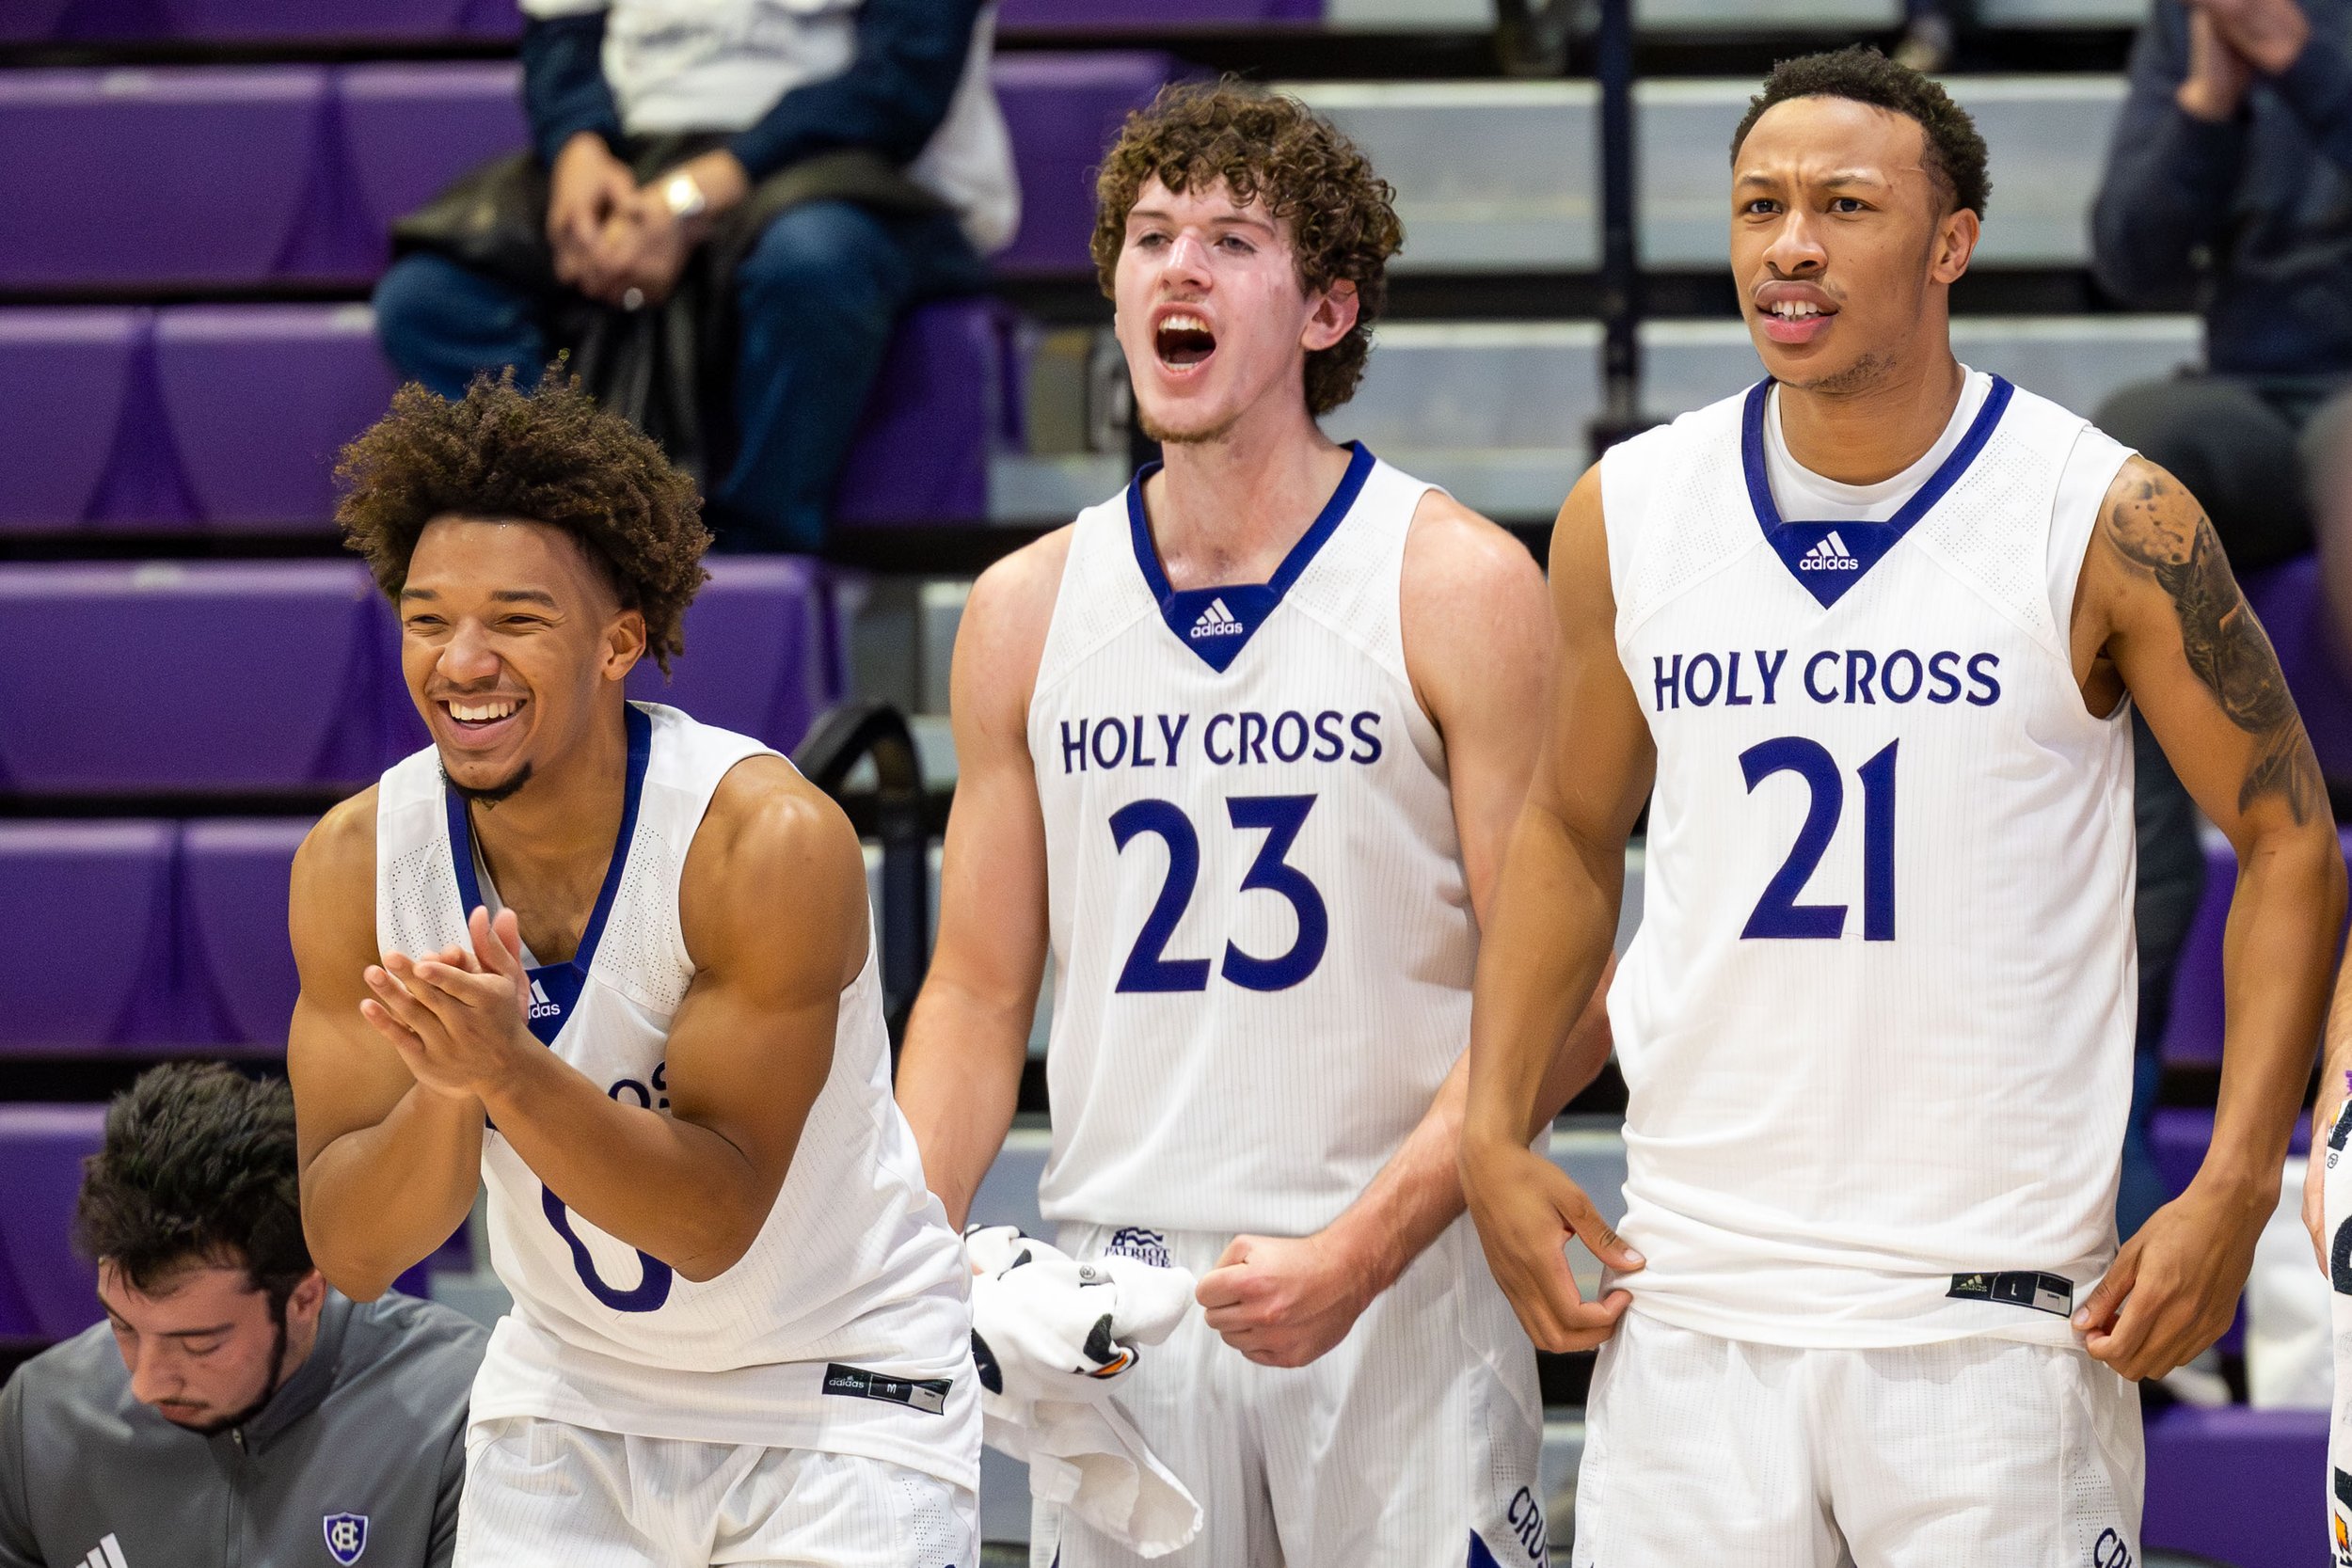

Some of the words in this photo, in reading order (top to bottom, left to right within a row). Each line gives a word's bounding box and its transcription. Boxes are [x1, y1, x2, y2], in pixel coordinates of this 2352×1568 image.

[1799, 554, 1859, 572] adidas
[1189, 611, 1244, 640] adidas
[1653, 649, 1788, 712] HOLY
[1804, 648, 2001, 707] CROSS
[1060, 713, 1190, 775] HOLY
[1203, 710, 1383, 766] CROSS
[1738, 736, 1900, 942] 21
[1107, 793, 1329, 993] 23
[2010, 1283, 2017, 1296] L
[828, 1378, 865, 1389] adidas
[886, 1383, 897, 1395] M
